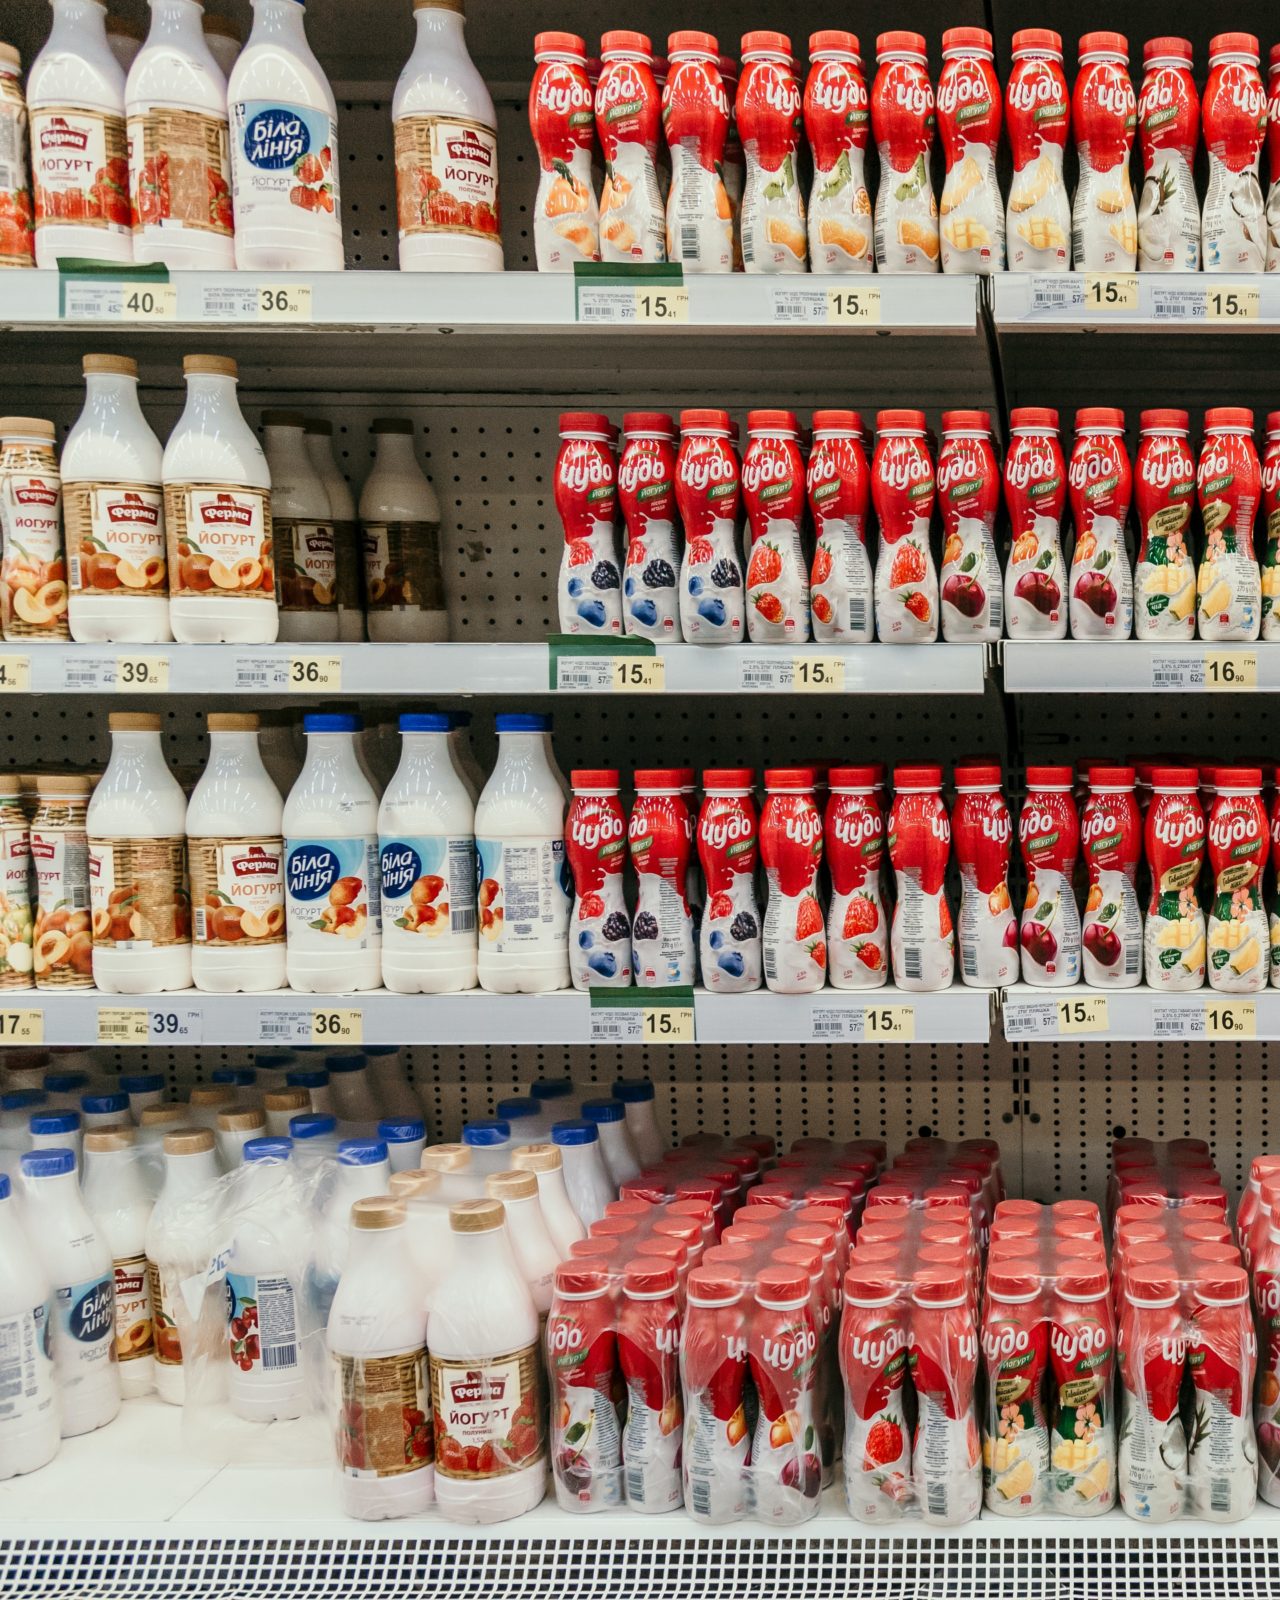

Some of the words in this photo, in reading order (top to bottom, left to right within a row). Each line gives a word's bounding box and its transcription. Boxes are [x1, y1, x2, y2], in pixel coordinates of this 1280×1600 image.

[445, 166, 494, 188] ЙОГУРТ
[126, 292, 154, 313] 40
[262, 291, 288, 311] 36
[288, 303, 298, 311] 90
[1091, 283, 1117, 302] 15
[640, 296, 667, 318] 15
[832, 294, 858, 315] 15
[1212, 295, 1238, 315] 15
[16, 516, 59, 530] ЙОГУРТ
[111, 508, 156, 521] Ферма
[204, 508, 249, 521] Ферма
[106, 531, 163, 545] ЙОГУРТ
[199, 531, 255, 545] ЙОГУРТ
[122, 663, 148, 683] 39
[292, 663, 319, 682] 36
[617, 663, 643, 684] 15
[799, 663, 824, 683] 15
[1209, 662, 1234, 682] 16
[1235, 674, 1245, 682] 90
[236, 860, 277, 871] Ферма
[231, 881, 283, 896] ЙОГУРТ
[868, 1010, 893, 1031] 15
[1060, 1002, 1086, 1022] 15
[1209, 1010, 1233, 1030] 16
[0, 1014, 19, 1034] 17
[21, 1027, 30, 1035] 55
[153, 1014, 178, 1033] 39
[315, 1014, 340, 1033] 36
[646, 1013, 671, 1034] 15
[450, 1407, 509, 1426] ЙОГУРТ
